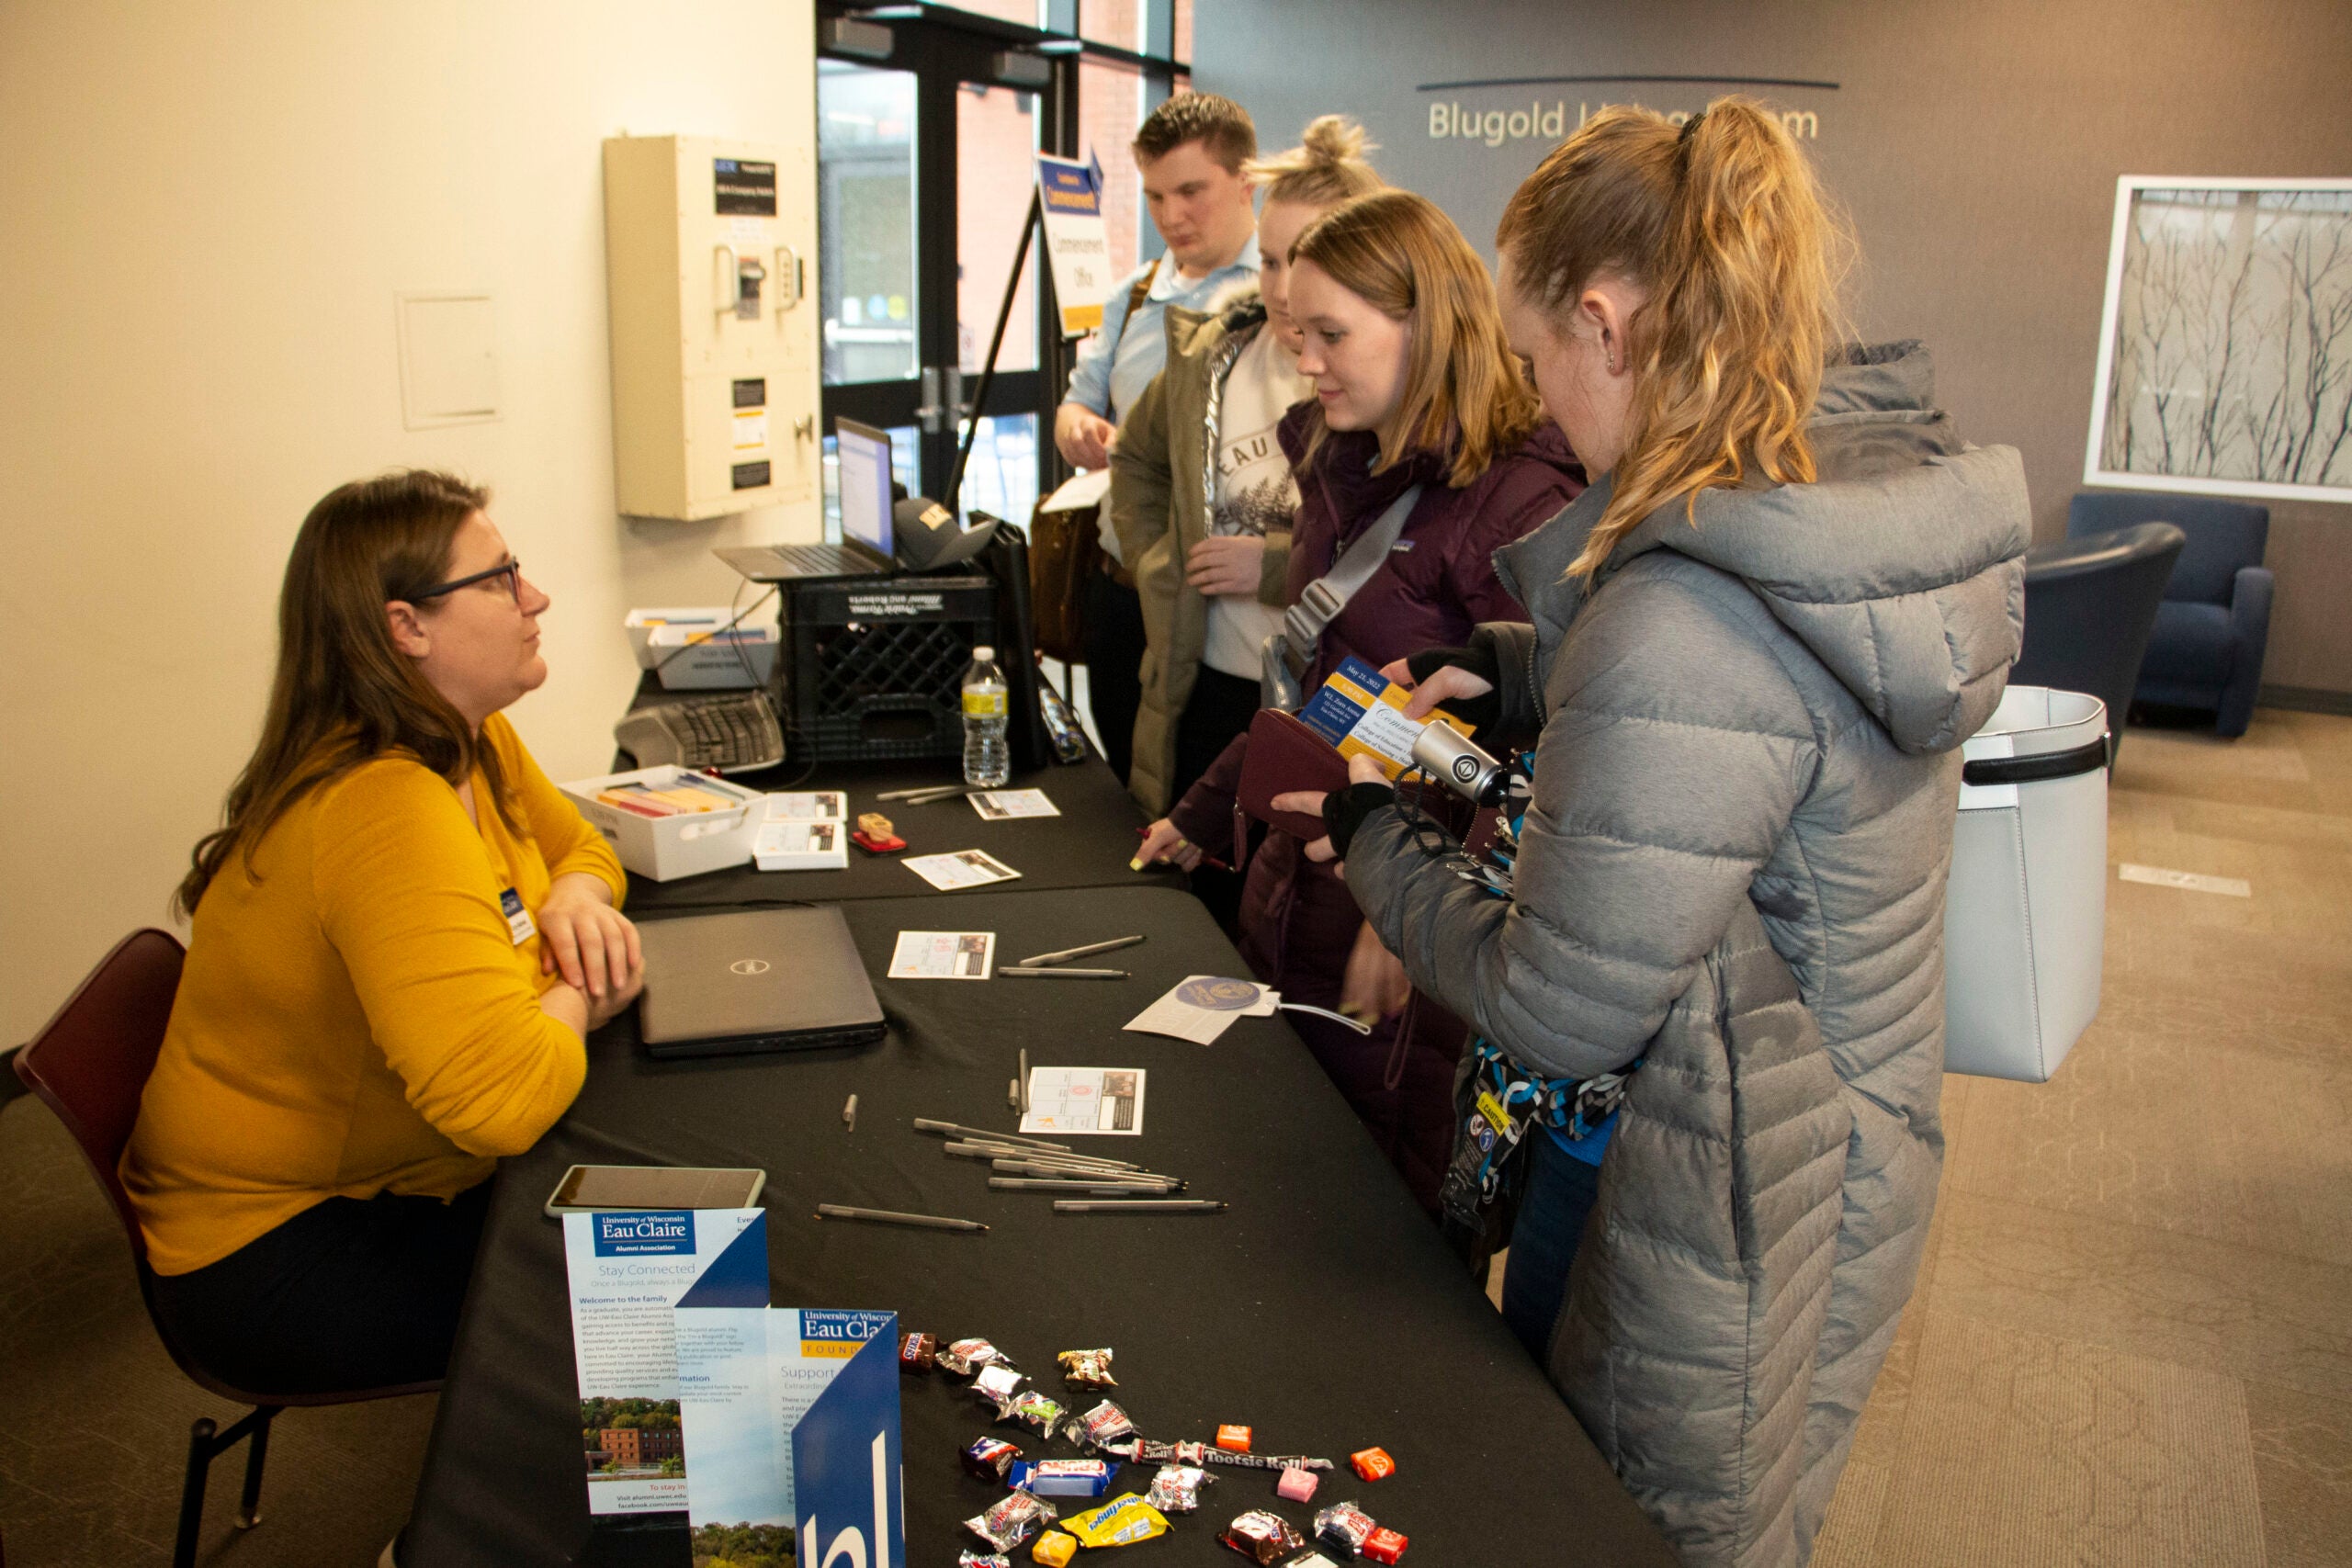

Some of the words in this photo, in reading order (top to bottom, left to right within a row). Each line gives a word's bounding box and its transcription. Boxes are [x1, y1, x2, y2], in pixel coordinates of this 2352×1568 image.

[1430, 101, 1564, 147] Blugold
[1218, 437, 1269, 478] EAU
[1346, 665, 1359, 676] May
[1366, 678, 1380, 689] 2022
[1354, 730, 1371, 743] College
[1376, 743, 1394, 758] Nursing
[1358, 722, 1374, 735] College
[1381, 737, 1402, 752] Education
[1483, 1104, 1505, 1131] CAUTION
[603, 1224, 634, 1238] Eau
[636, 1223, 686, 1237] Claire
[599, 1265, 625, 1278] Stay
[628, 1263, 695, 1276] Connected
[642, 1295, 668, 1303] family
[805, 1312, 849, 1322] University
[805, 1321, 843, 1337] Eau
[846, 1321, 883, 1338] Cla
[807, 1345, 858, 1354] FOUND
[781, 1366, 834, 1380] Support
[1204, 1450, 1264, 1468] Tootsie
[1266, 1456, 1302, 1470] Roll
